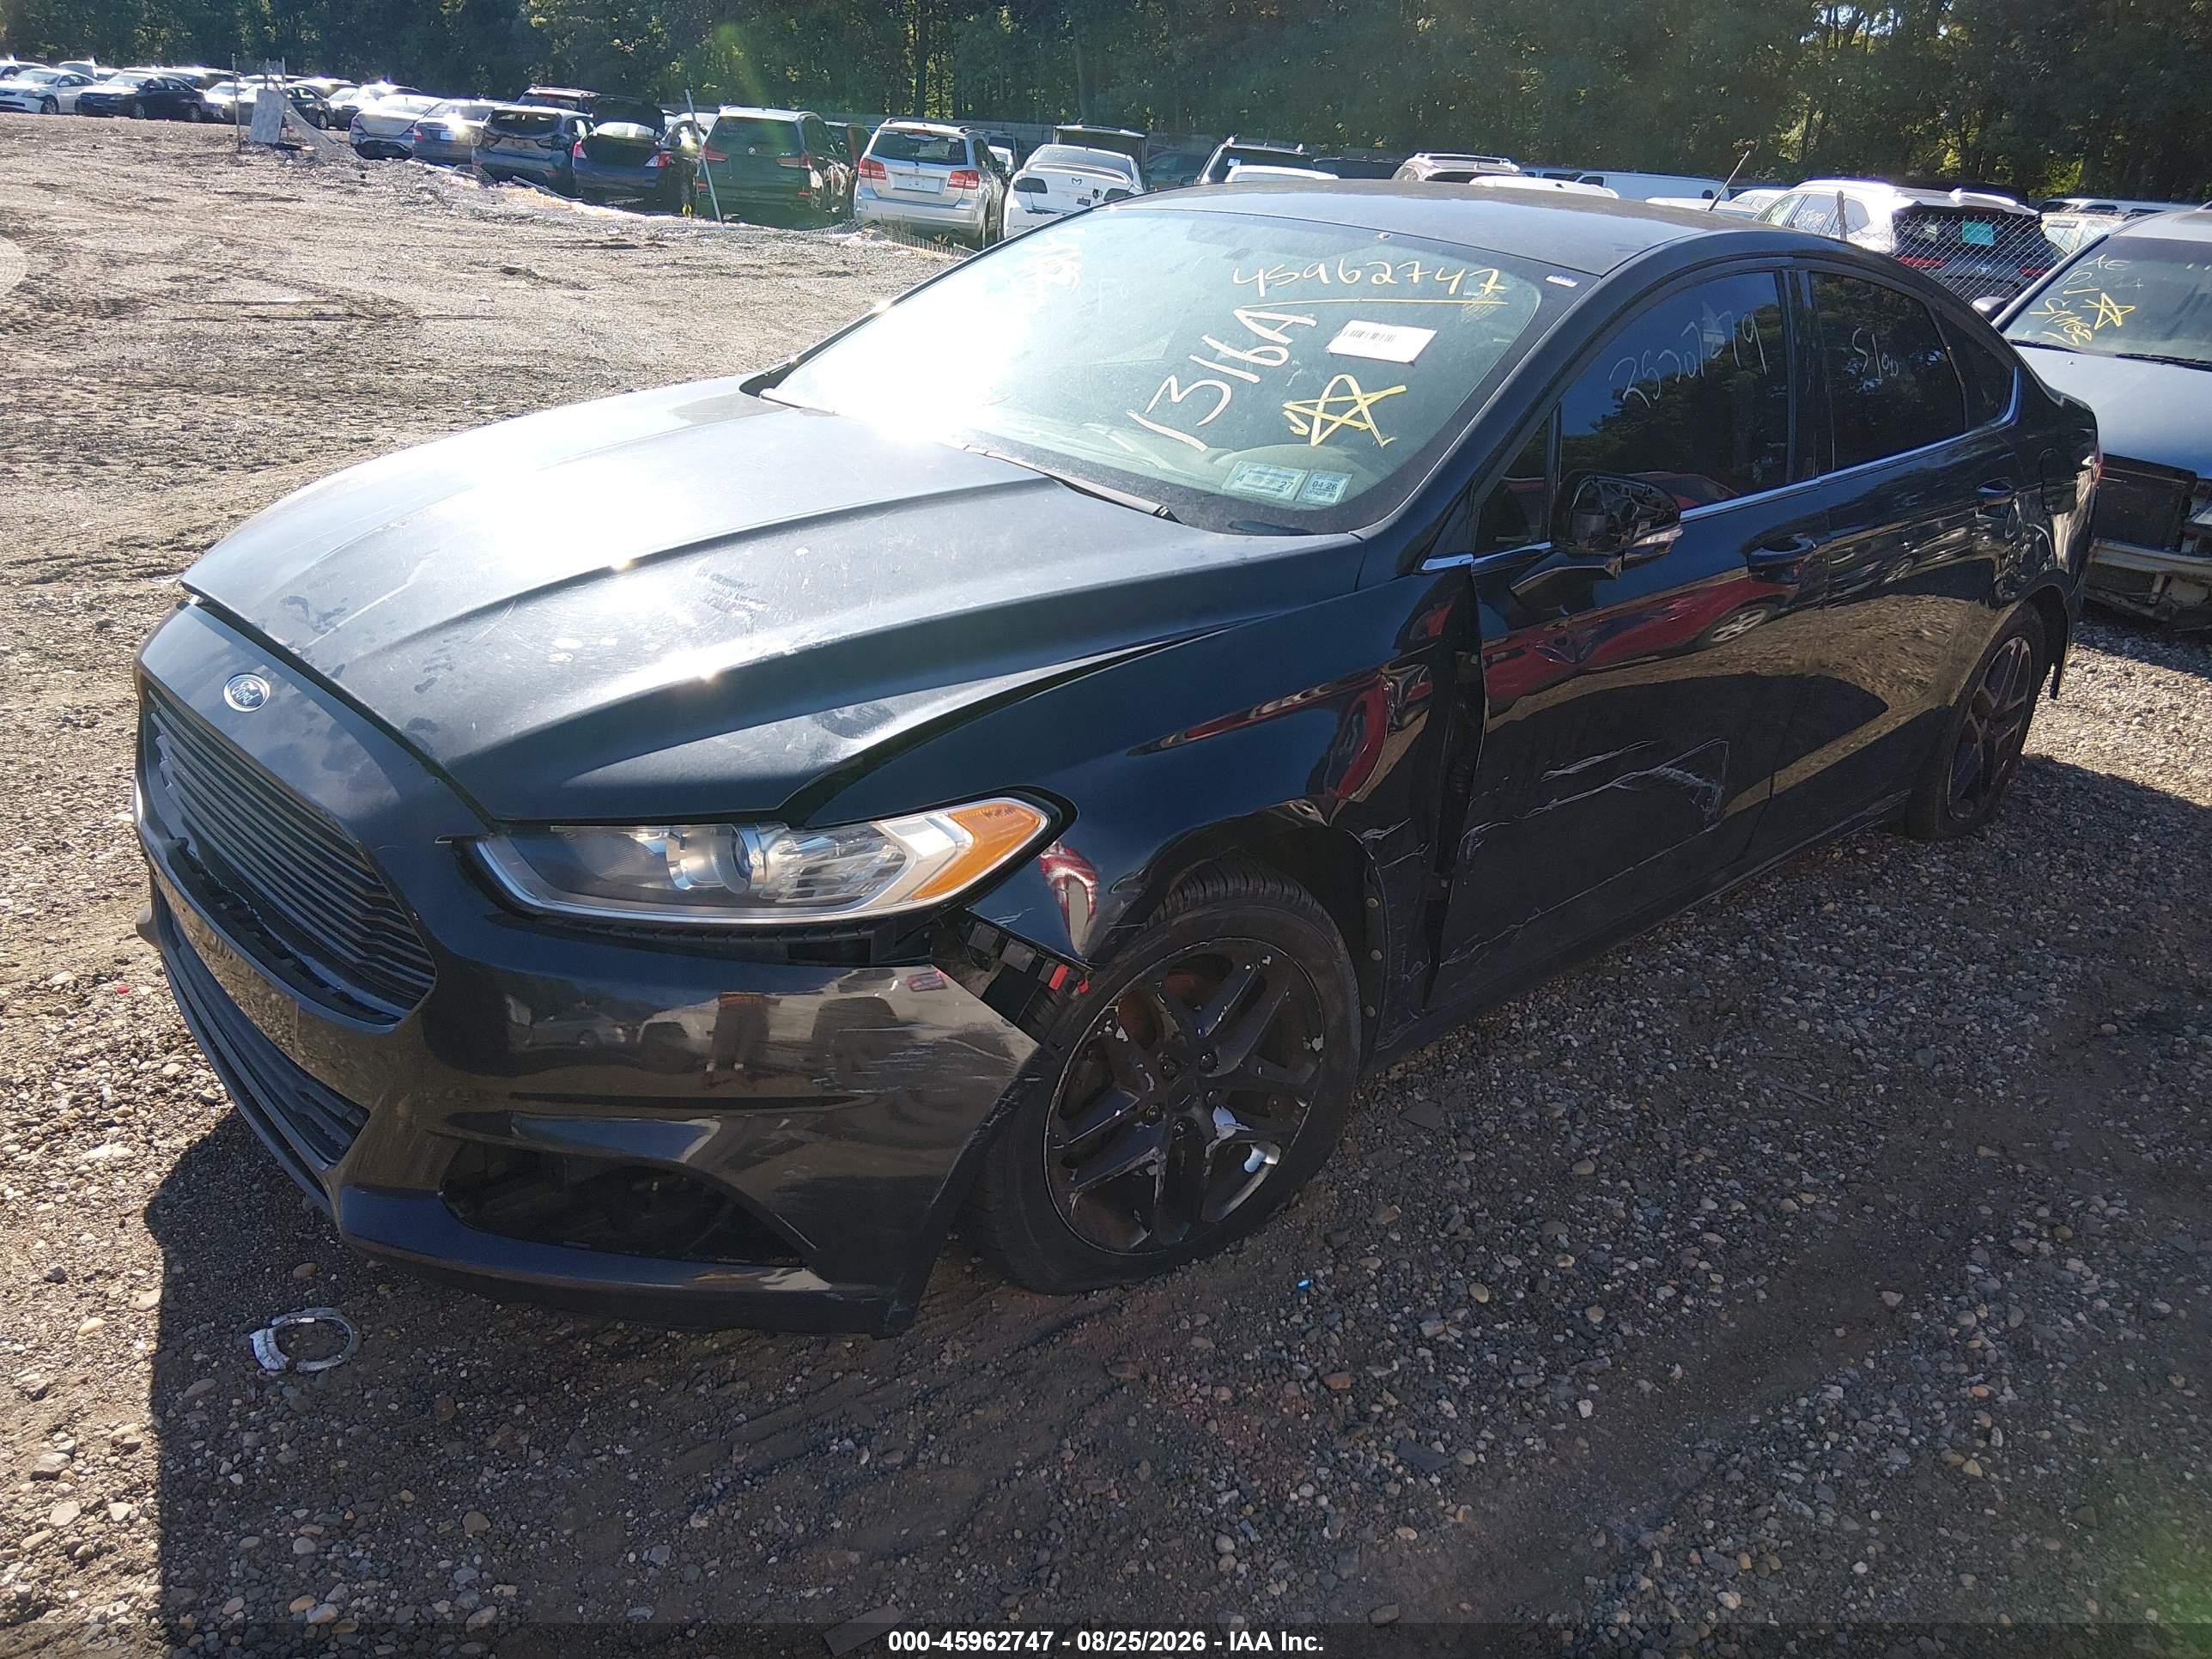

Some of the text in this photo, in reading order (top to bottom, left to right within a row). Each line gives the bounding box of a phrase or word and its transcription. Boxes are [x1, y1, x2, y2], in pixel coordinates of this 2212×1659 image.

[1127, 308, 1318, 453] 1316A
[1278, 481, 1293, 490] 27
[231, 681, 259, 705] Ford
